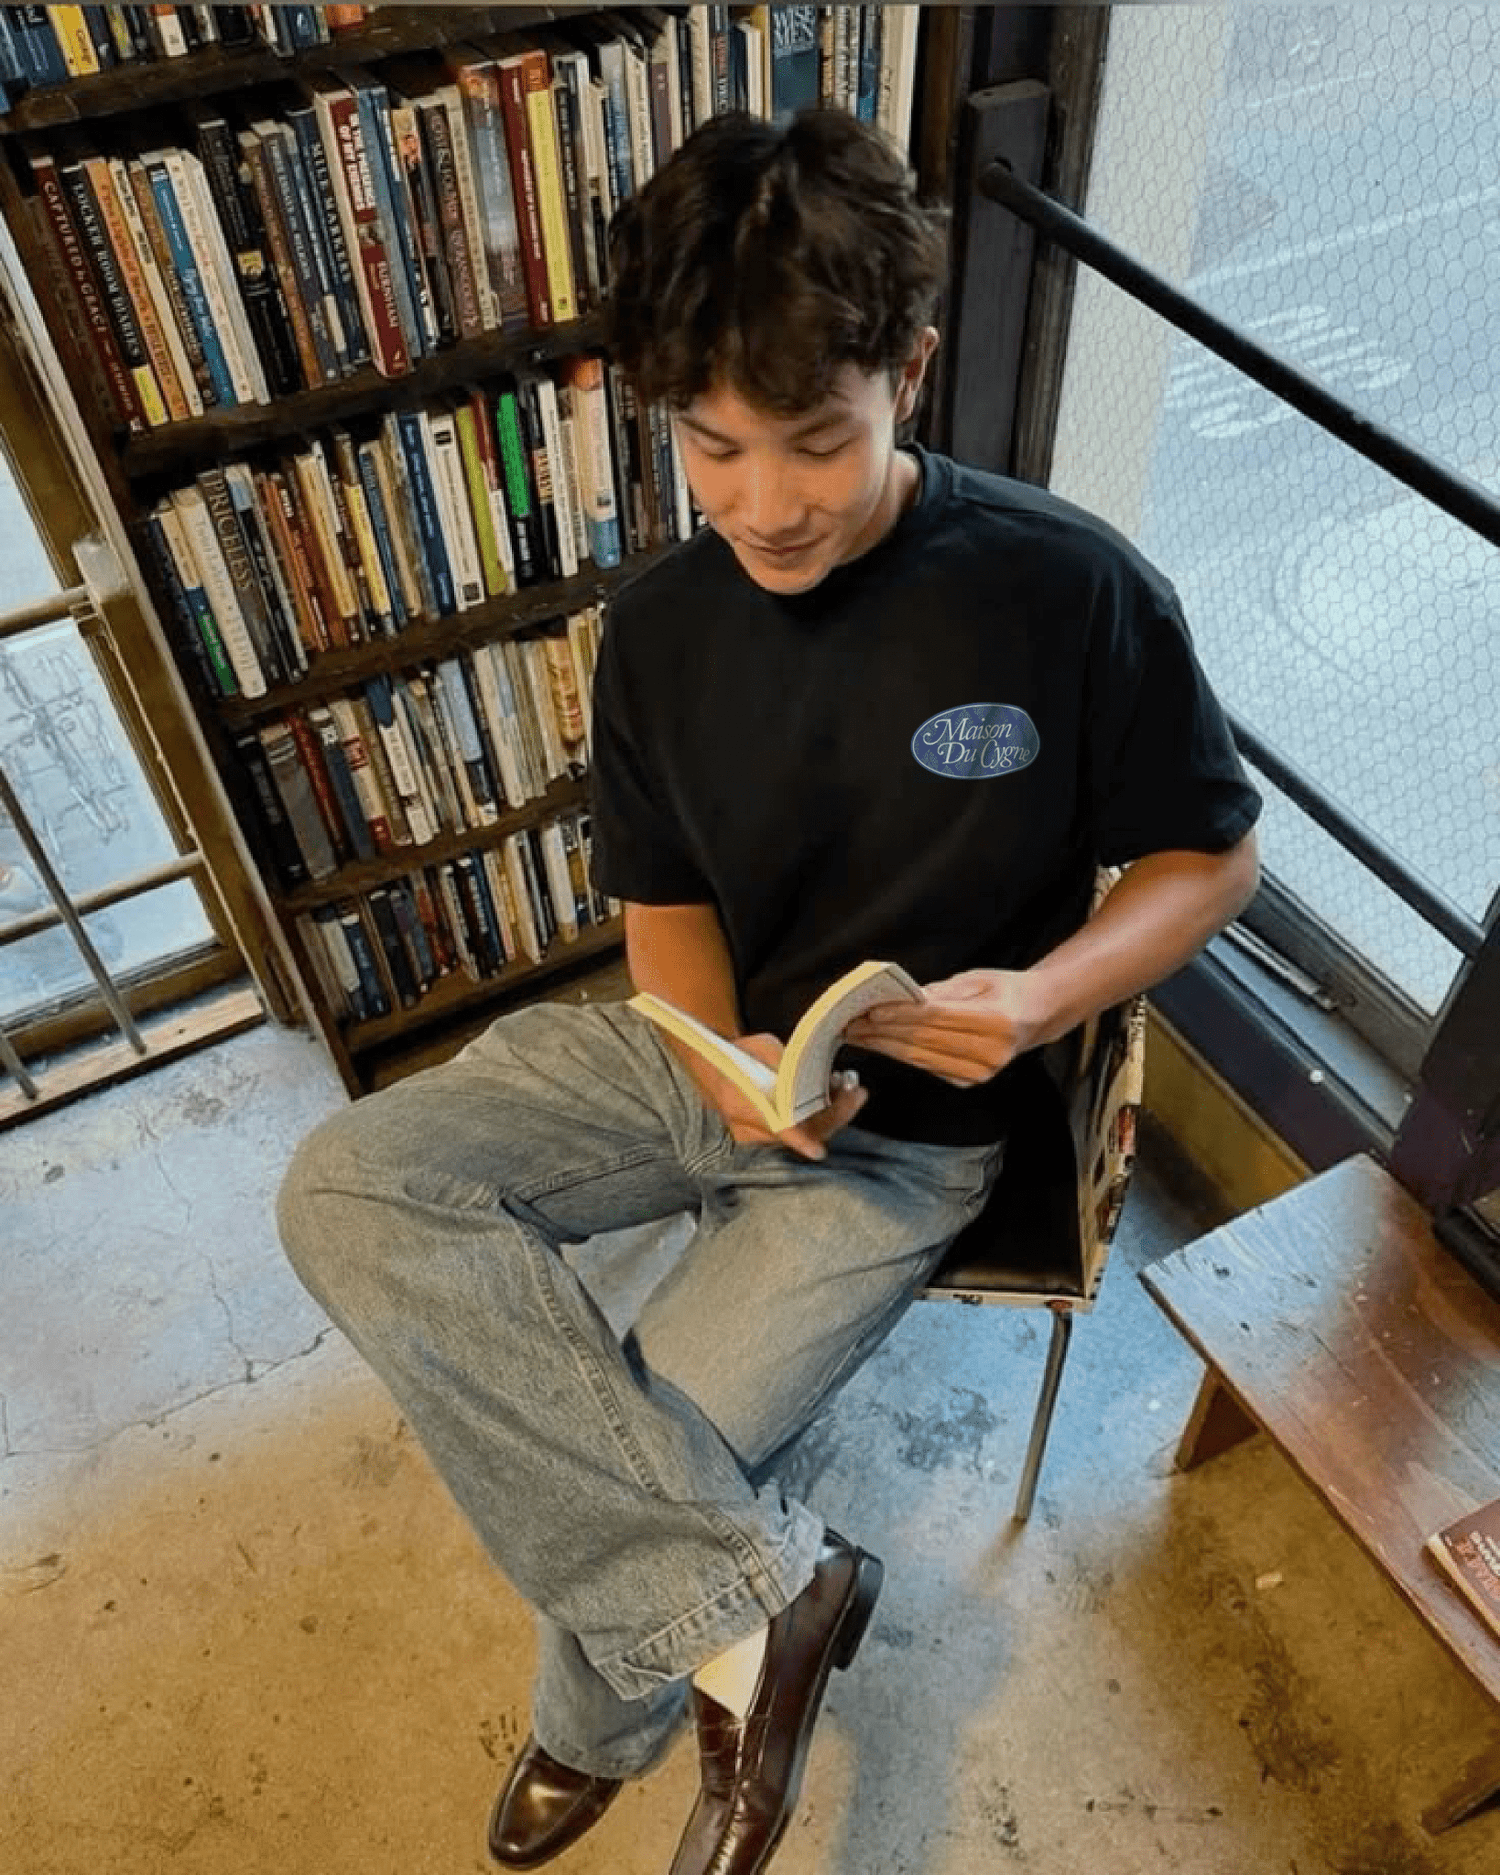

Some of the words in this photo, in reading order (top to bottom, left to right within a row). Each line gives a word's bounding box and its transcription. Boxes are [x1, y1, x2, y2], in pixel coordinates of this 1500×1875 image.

[923, 718, 1012, 745] Maison
[937, 741, 976, 764] Du
[981, 739, 1031, 769] Cygne
